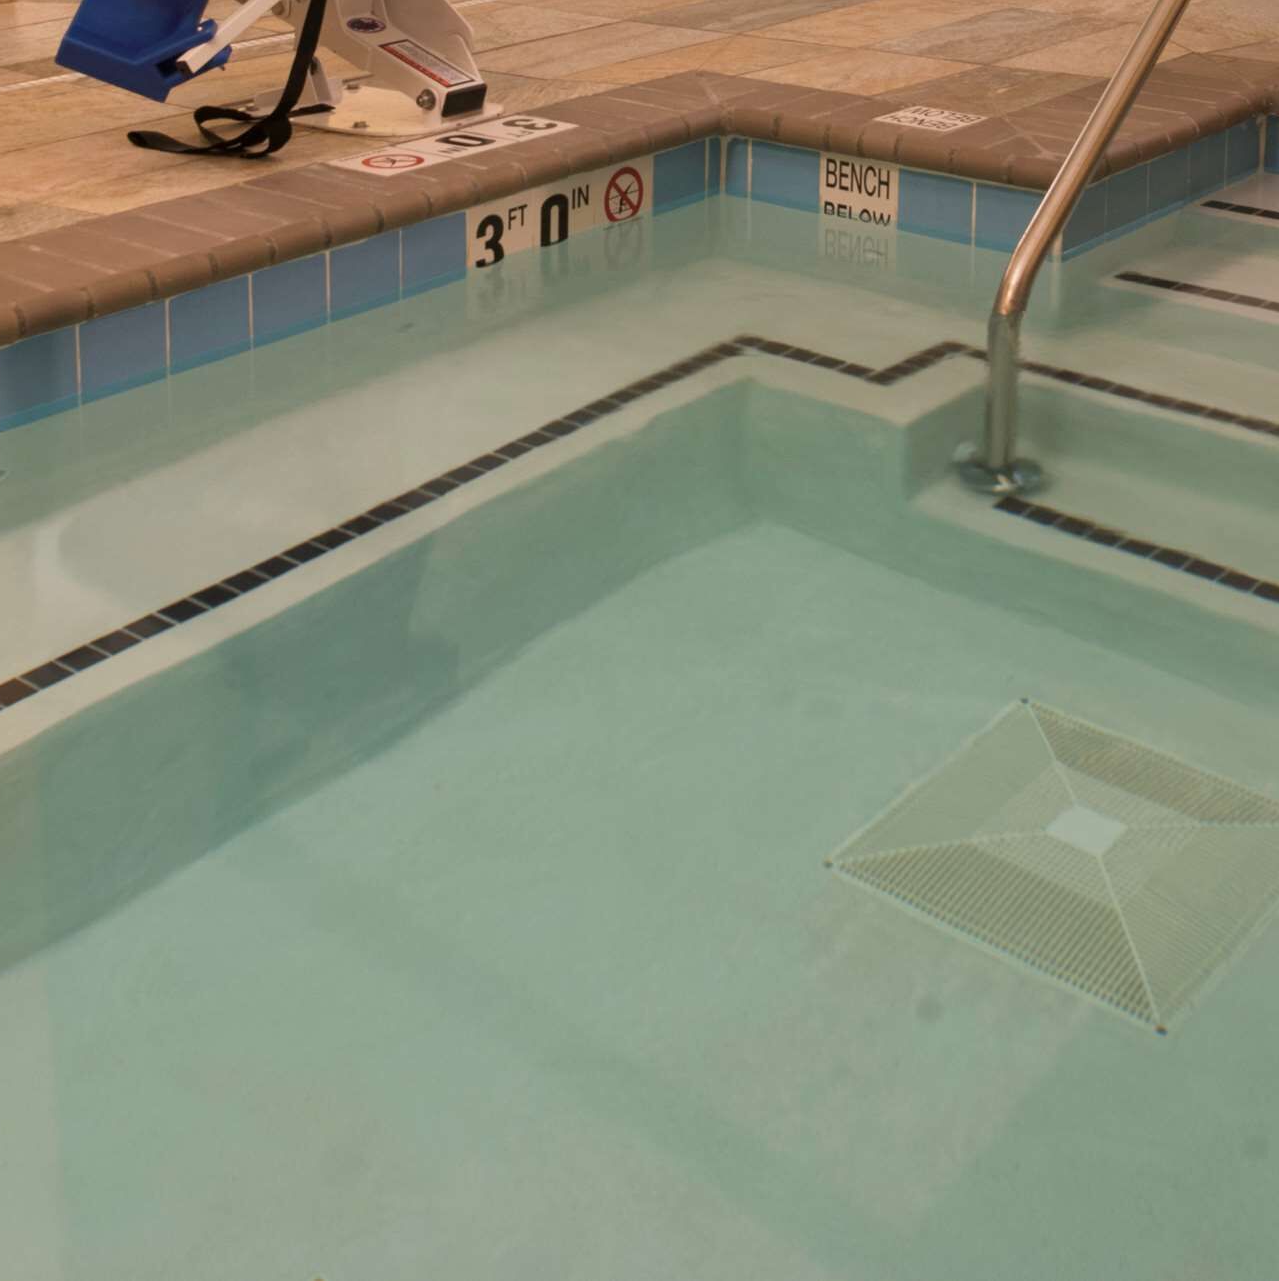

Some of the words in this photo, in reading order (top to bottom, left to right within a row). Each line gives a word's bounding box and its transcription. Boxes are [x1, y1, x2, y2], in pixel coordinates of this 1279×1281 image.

[825, 158, 891, 199] BENCH
[475, 214, 505, 268] 3
[508, 204, 528, 230] FT
[572, 184, 590, 210] IN
[823, 201, 892, 227] BELOW
